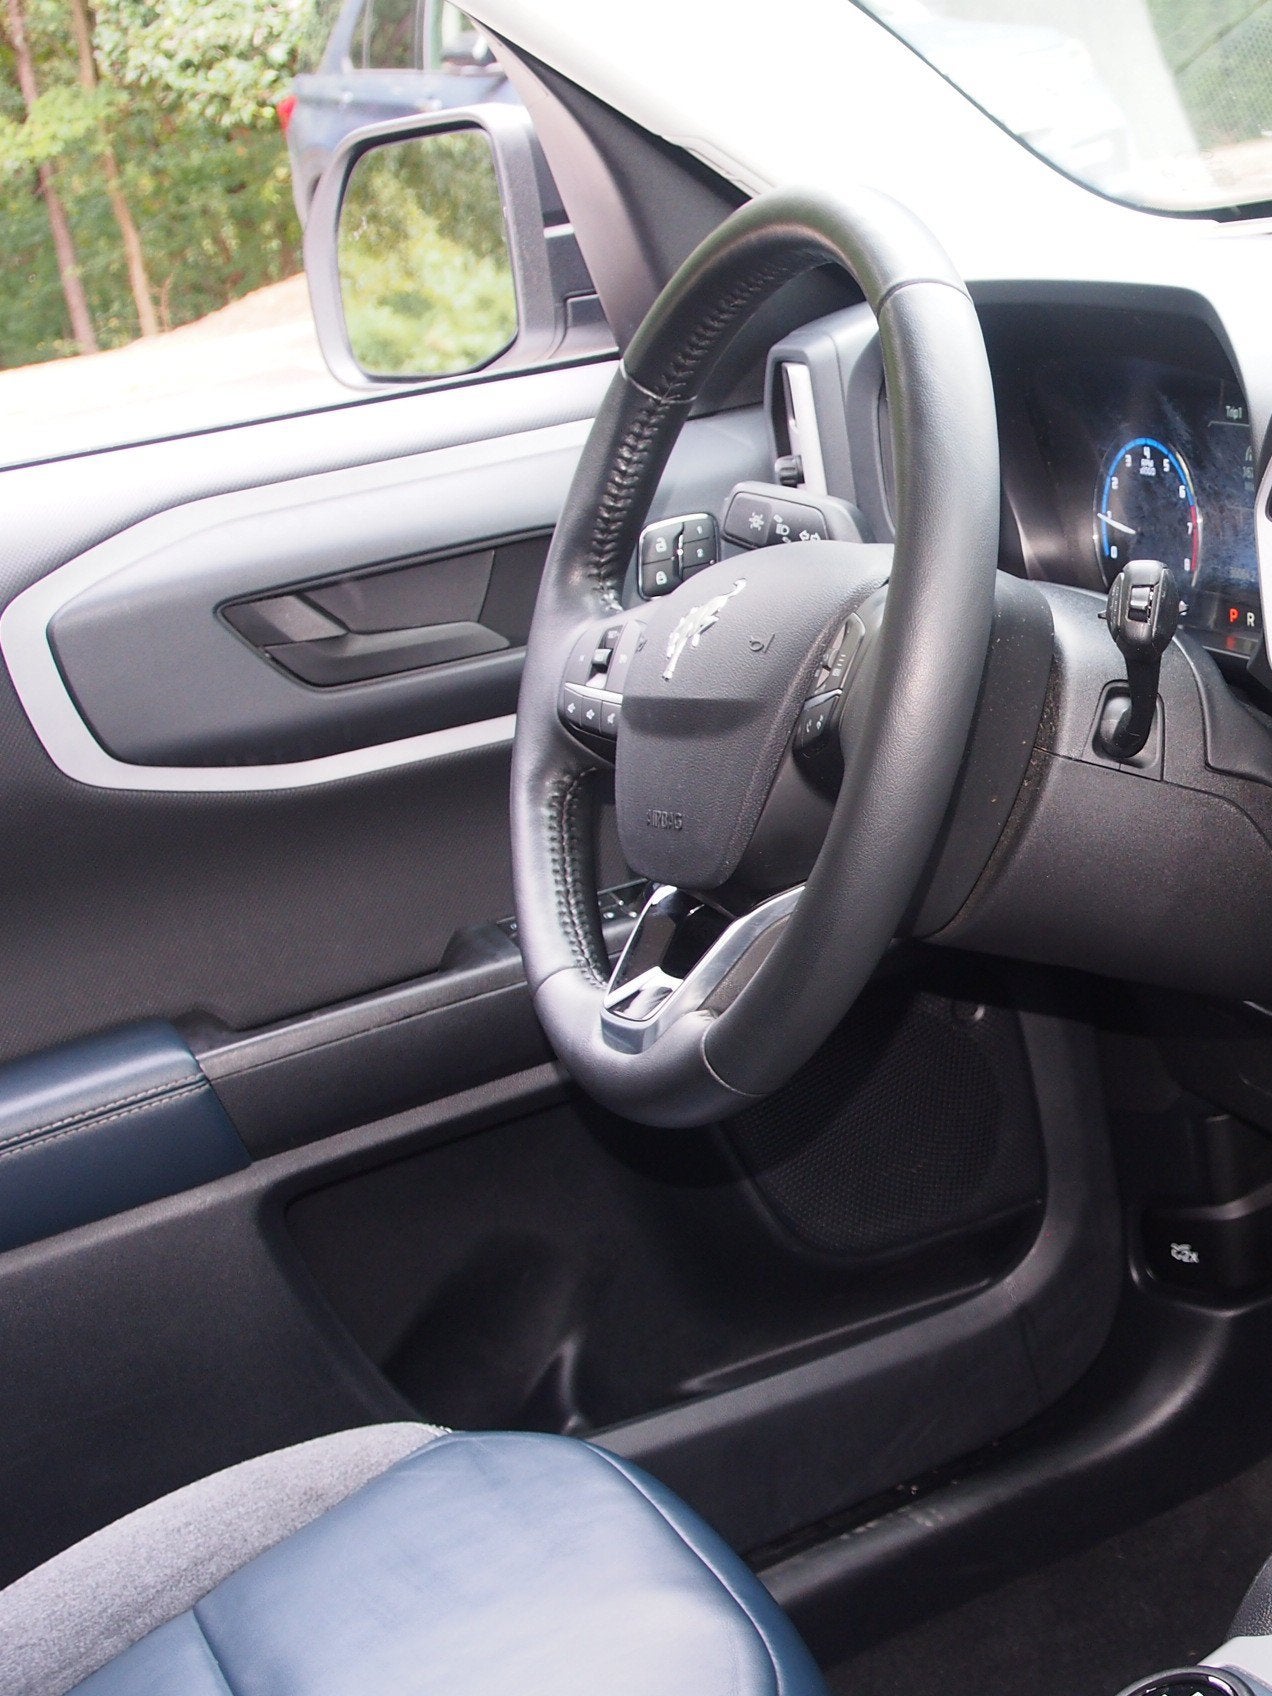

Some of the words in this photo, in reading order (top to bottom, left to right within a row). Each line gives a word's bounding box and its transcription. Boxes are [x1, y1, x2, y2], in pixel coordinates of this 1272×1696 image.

[1124, 454, 1132, 468] 3
[1163, 458, 1170, 472] 5
[1111, 476, 1118, 490] 2
[1178, 485, 1186, 499] 6
[1229, 608, 1239, 622] P
[1246, 612, 1255, 627] R
